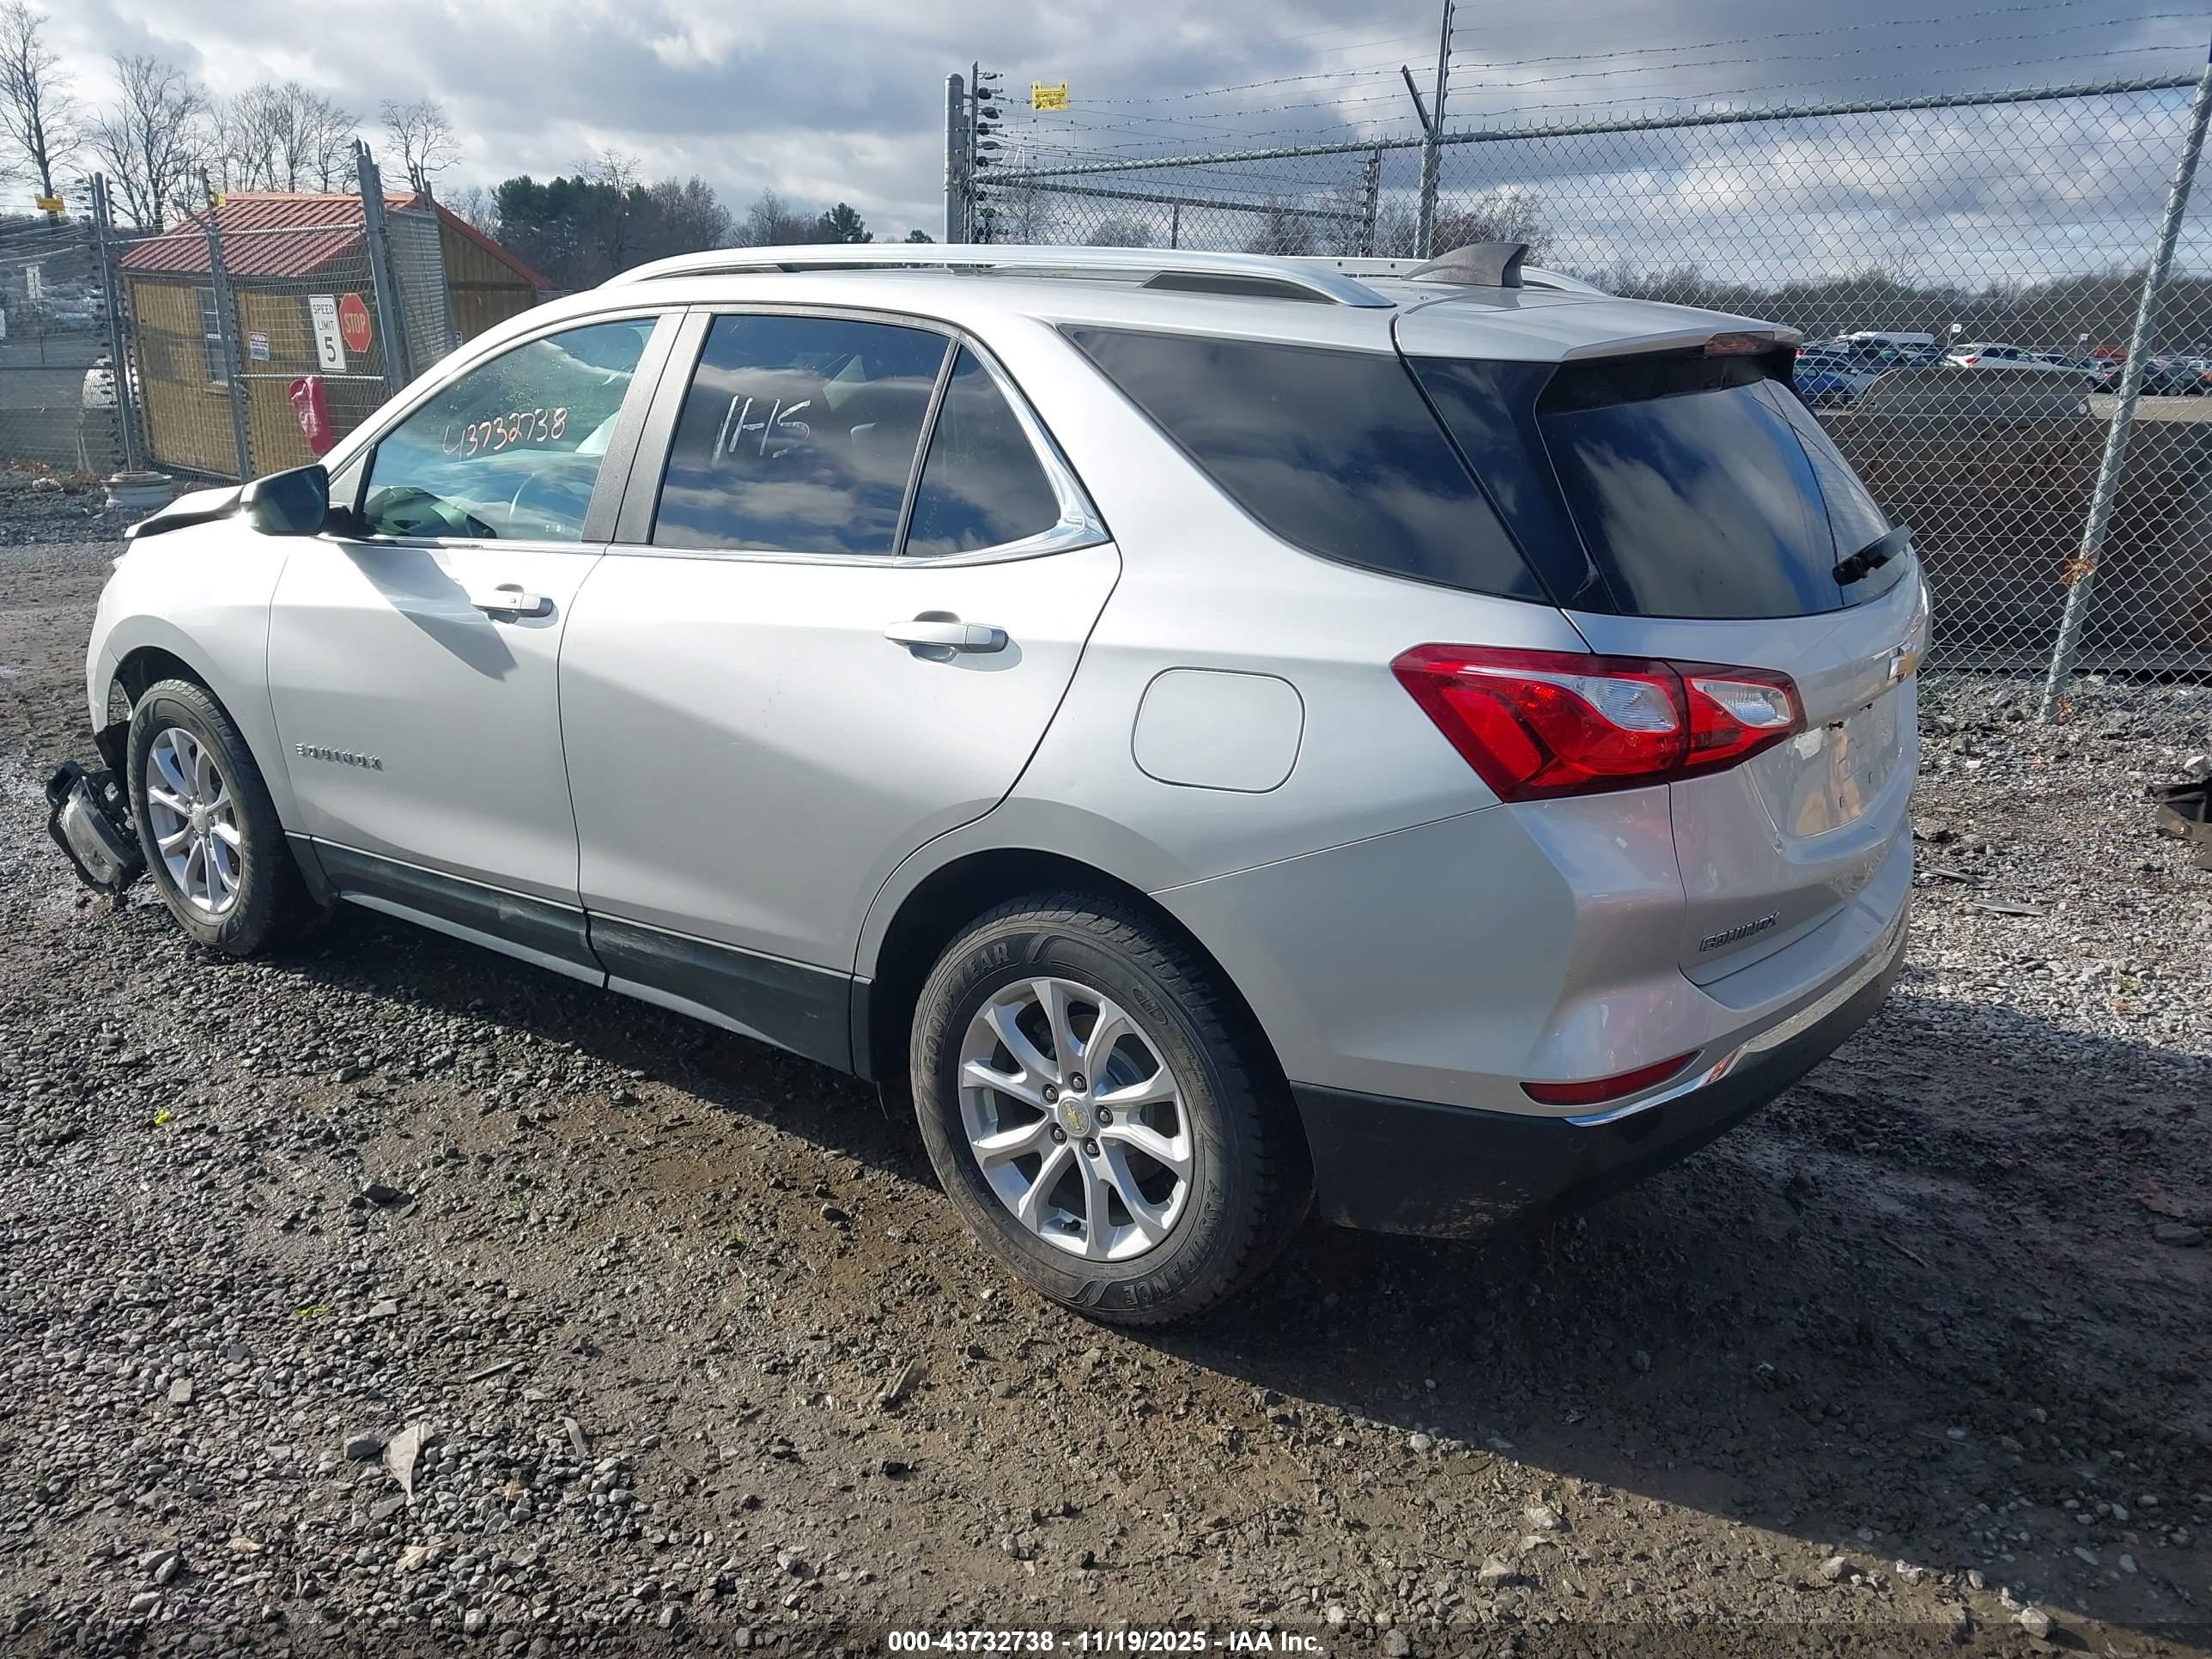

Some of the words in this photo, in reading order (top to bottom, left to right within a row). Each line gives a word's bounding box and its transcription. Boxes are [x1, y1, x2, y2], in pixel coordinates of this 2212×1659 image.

[313, 303, 335, 314] SPEED
[318, 320, 336, 331] LIMIT
[344, 313, 366, 334] STOP
[325, 336, 336, 362] 5
[442, 407, 568, 462] 43732738
[1699, 911, 1780, 952] EQUINOX
